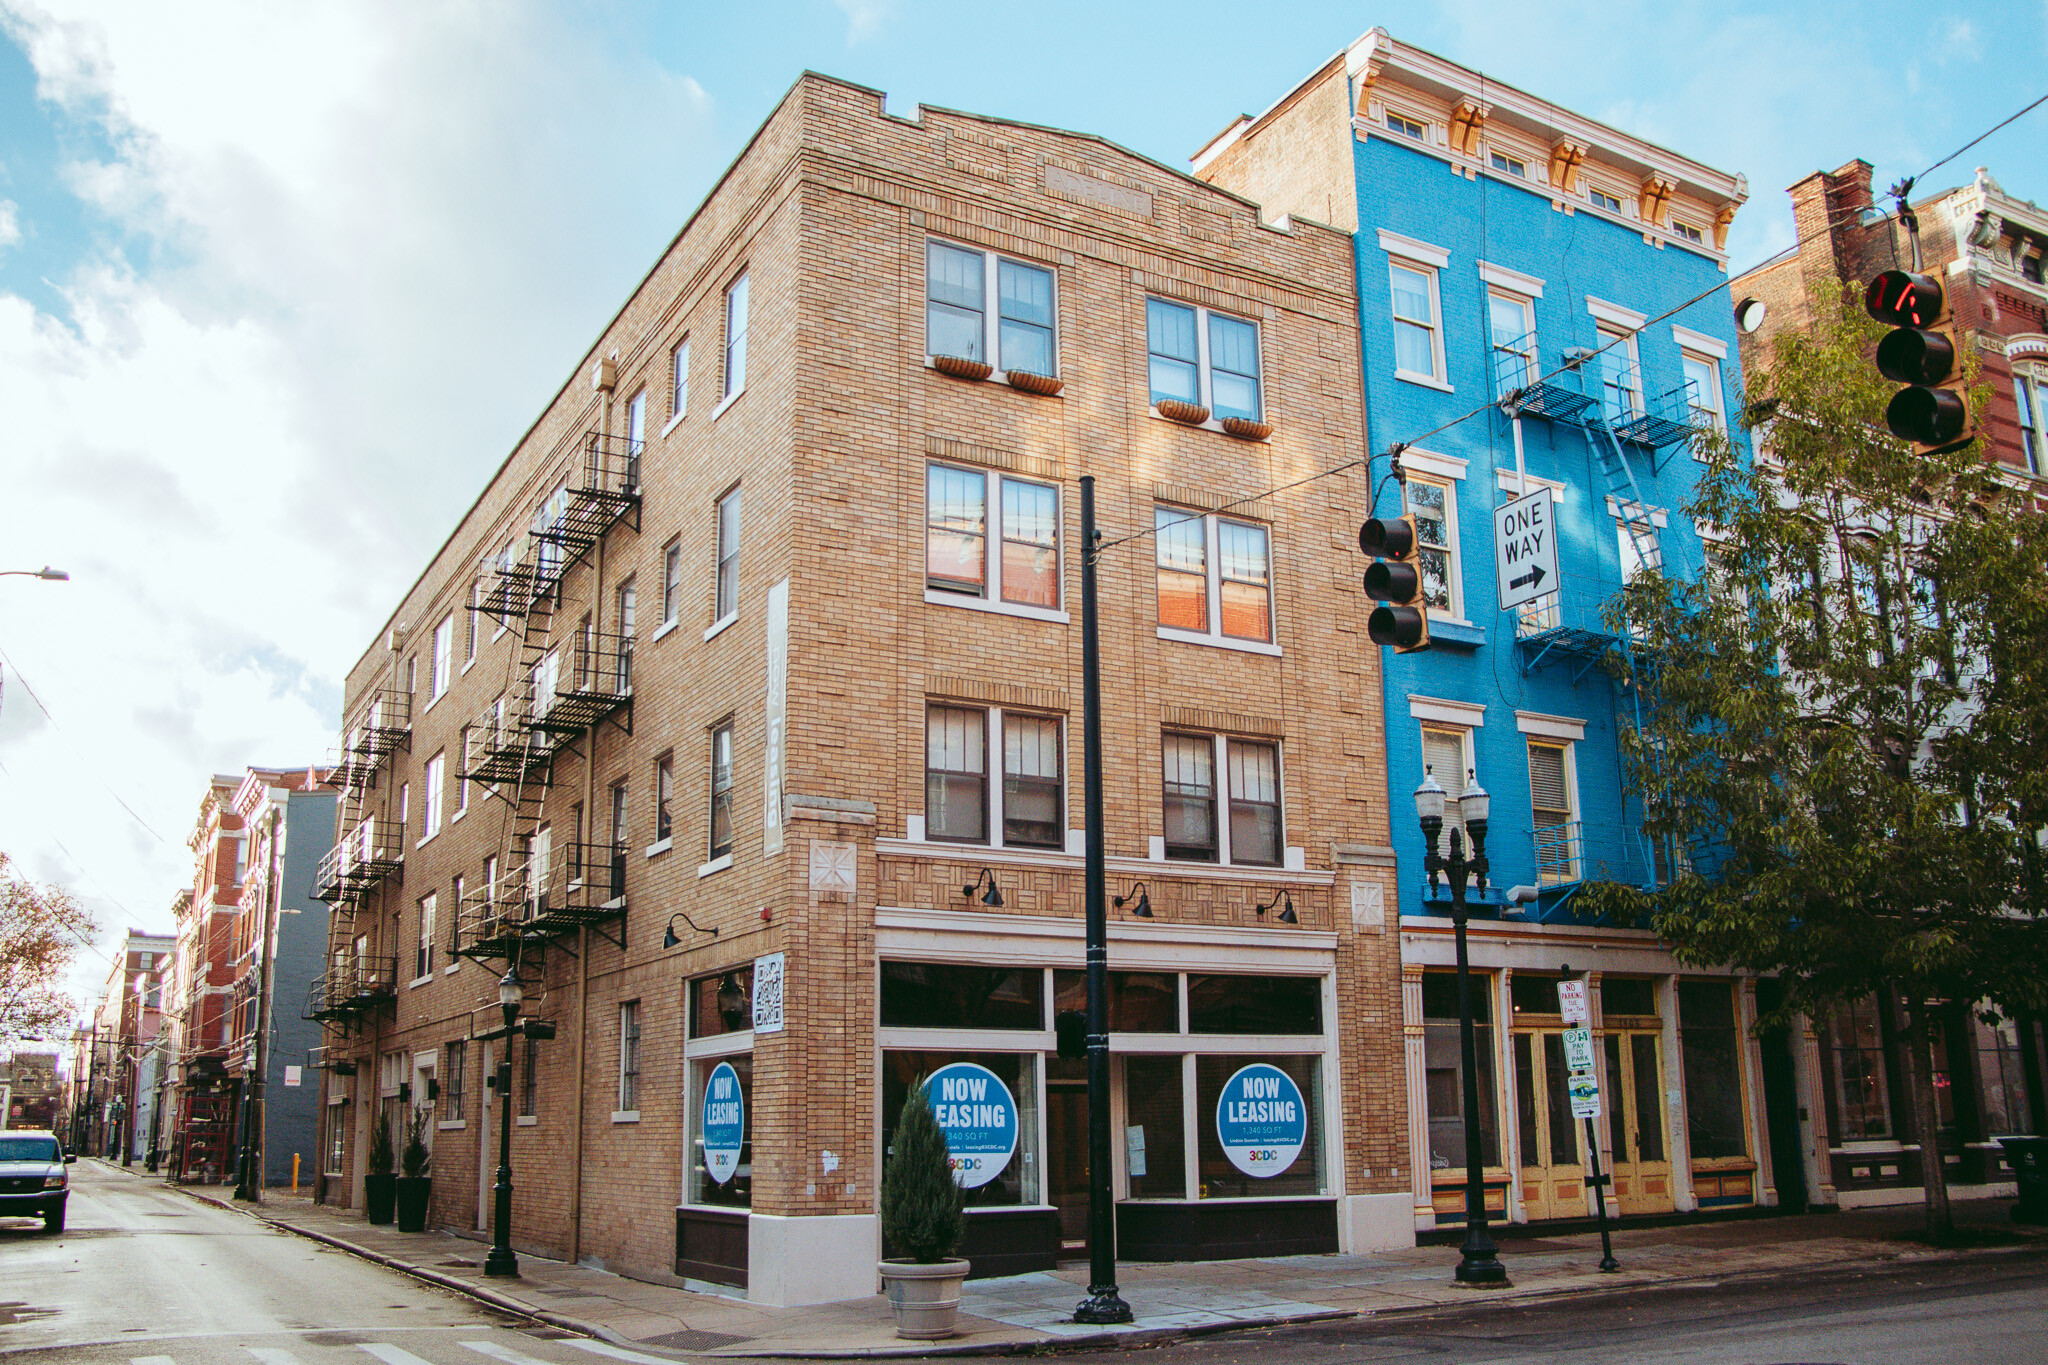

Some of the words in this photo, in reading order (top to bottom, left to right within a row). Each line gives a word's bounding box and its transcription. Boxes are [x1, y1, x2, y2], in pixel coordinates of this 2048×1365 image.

[1049, 171, 1144, 211] ADELINE
[1504, 501, 1543, 536] ONE
[1505, 529, 1544, 565] WAY
[771, 647, 780, 707] now
[767, 716, 781, 829] leasing
[714, 1077, 732, 1100] NOW
[942, 1078, 987, 1102] NOW
[1242, 1077, 1280, 1099] NOW
[707, 1101, 739, 1126] LEASING
[935, 1104, 1006, 1128] EASING
[1228, 1101, 1296, 1123] LEASING
[948, 1132, 963, 1140] 340
[965, 1132, 977, 1140] SQ
[715, 1154, 729, 1165] 3CDC
[1249, 1150, 1277, 1161] 3CDC
